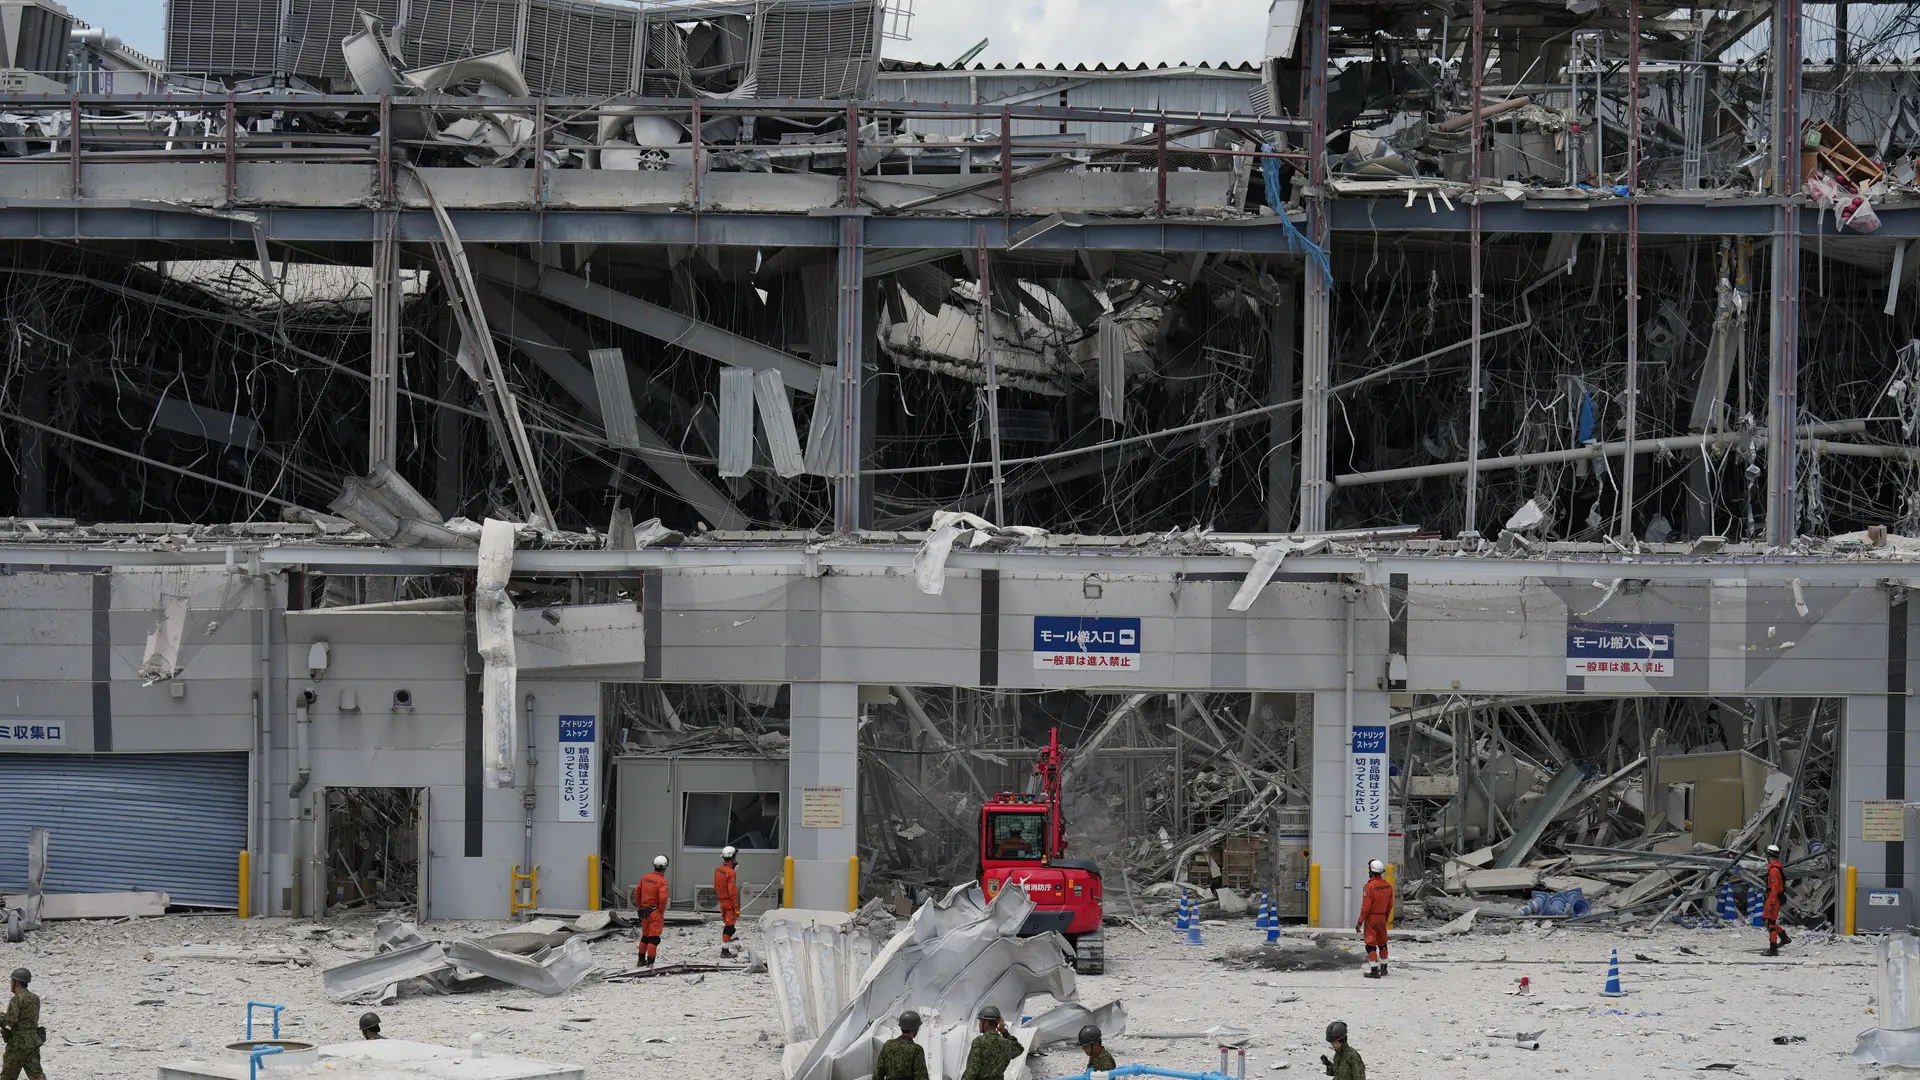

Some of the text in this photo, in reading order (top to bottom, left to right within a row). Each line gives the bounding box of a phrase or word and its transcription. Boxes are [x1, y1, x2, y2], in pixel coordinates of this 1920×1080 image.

[1043, 655, 1131, 667] 一般車は進入禁止
[560, 720, 594, 728] アイドリング
[565, 730, 589, 738] ストップ
[1352, 731, 1385, 739] アイドリング
[1356, 741, 1380, 749] ストップ
[564, 746, 575, 802] 切ってください
[578, 746, 590, 818] 納品時はエンジンを
[1355, 757, 1367, 813] 切ってください
[1369, 758, 1381, 829] 納品時はエンジンを
